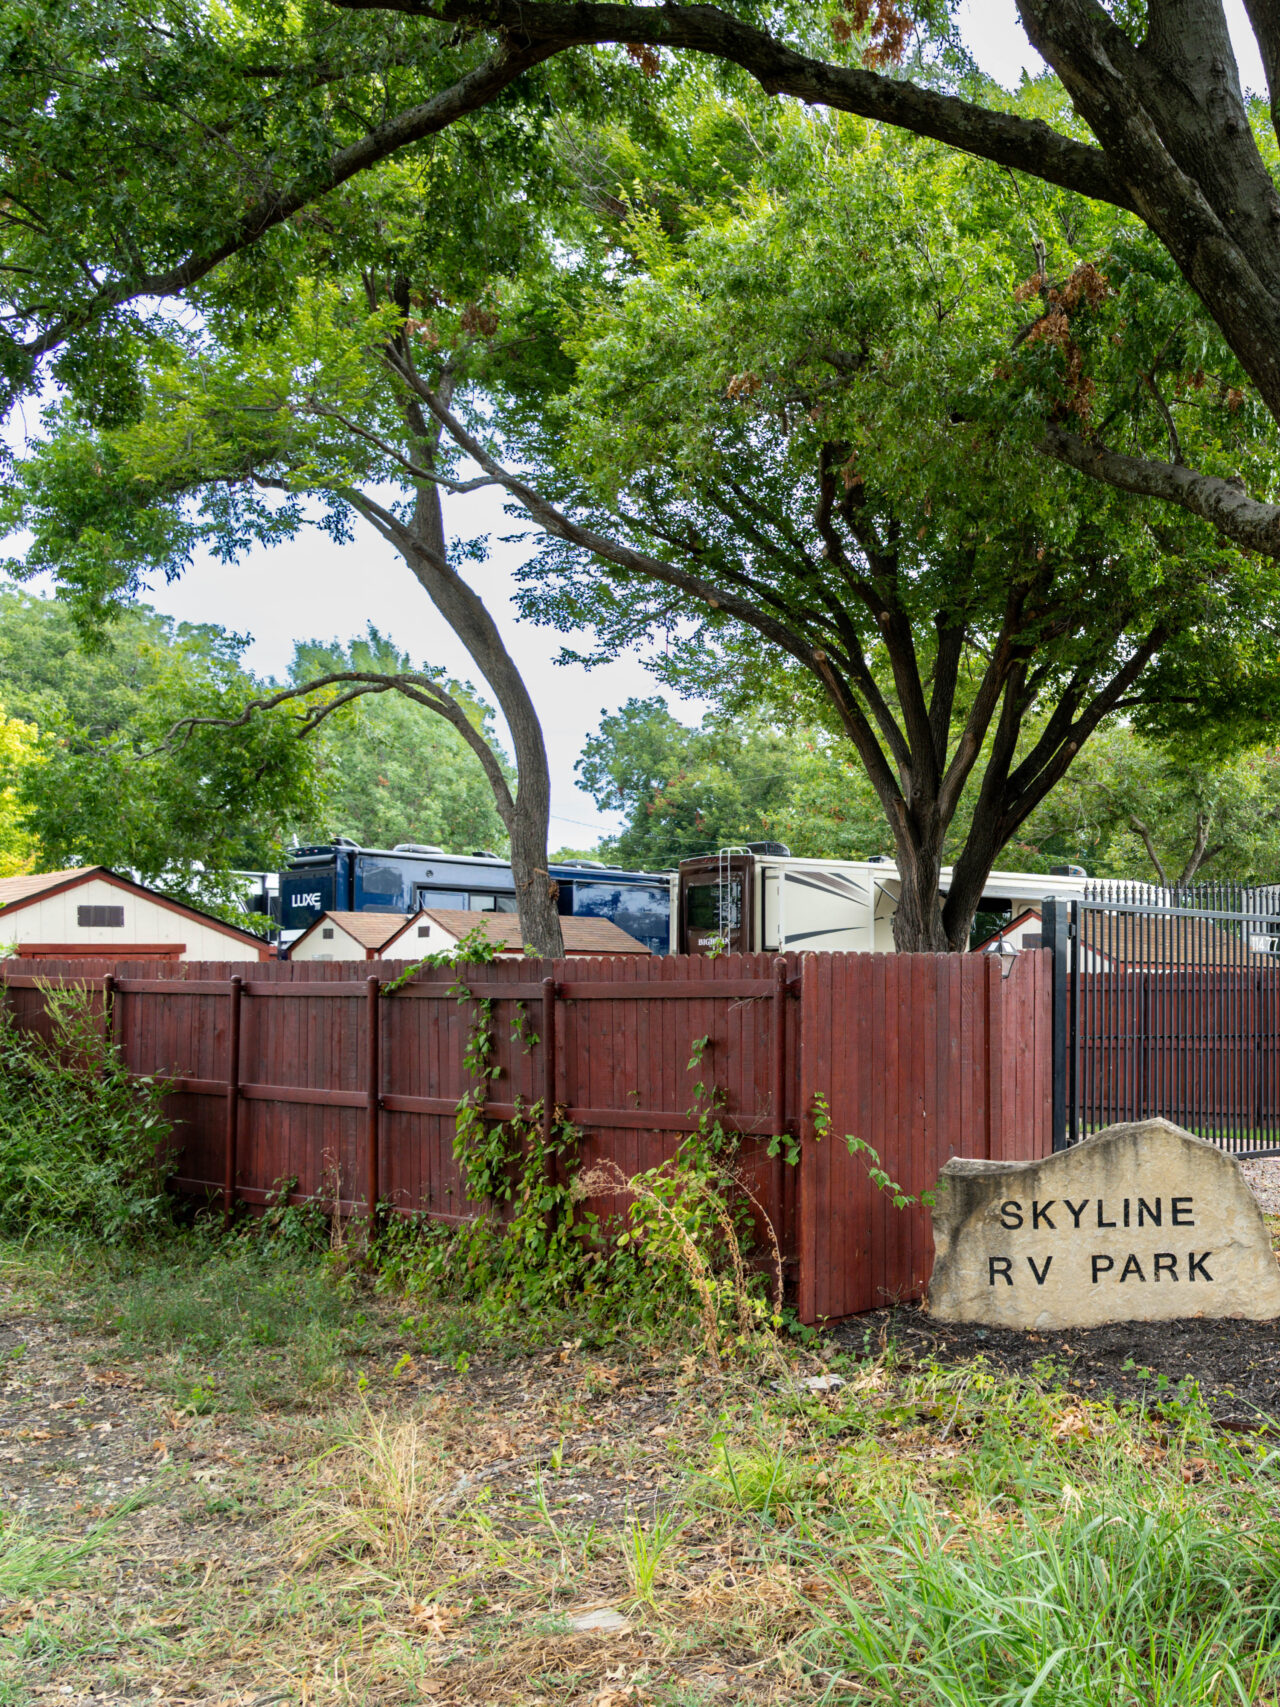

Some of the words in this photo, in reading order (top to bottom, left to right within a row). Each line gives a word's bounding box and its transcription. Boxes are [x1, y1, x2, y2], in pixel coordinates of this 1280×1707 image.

[291, 892, 321, 907] LUXE
[1000, 1197, 1195, 1230] SKYLINE
[989, 1255, 1053, 1286] RV
[1091, 1252, 1214, 1284] PARK
